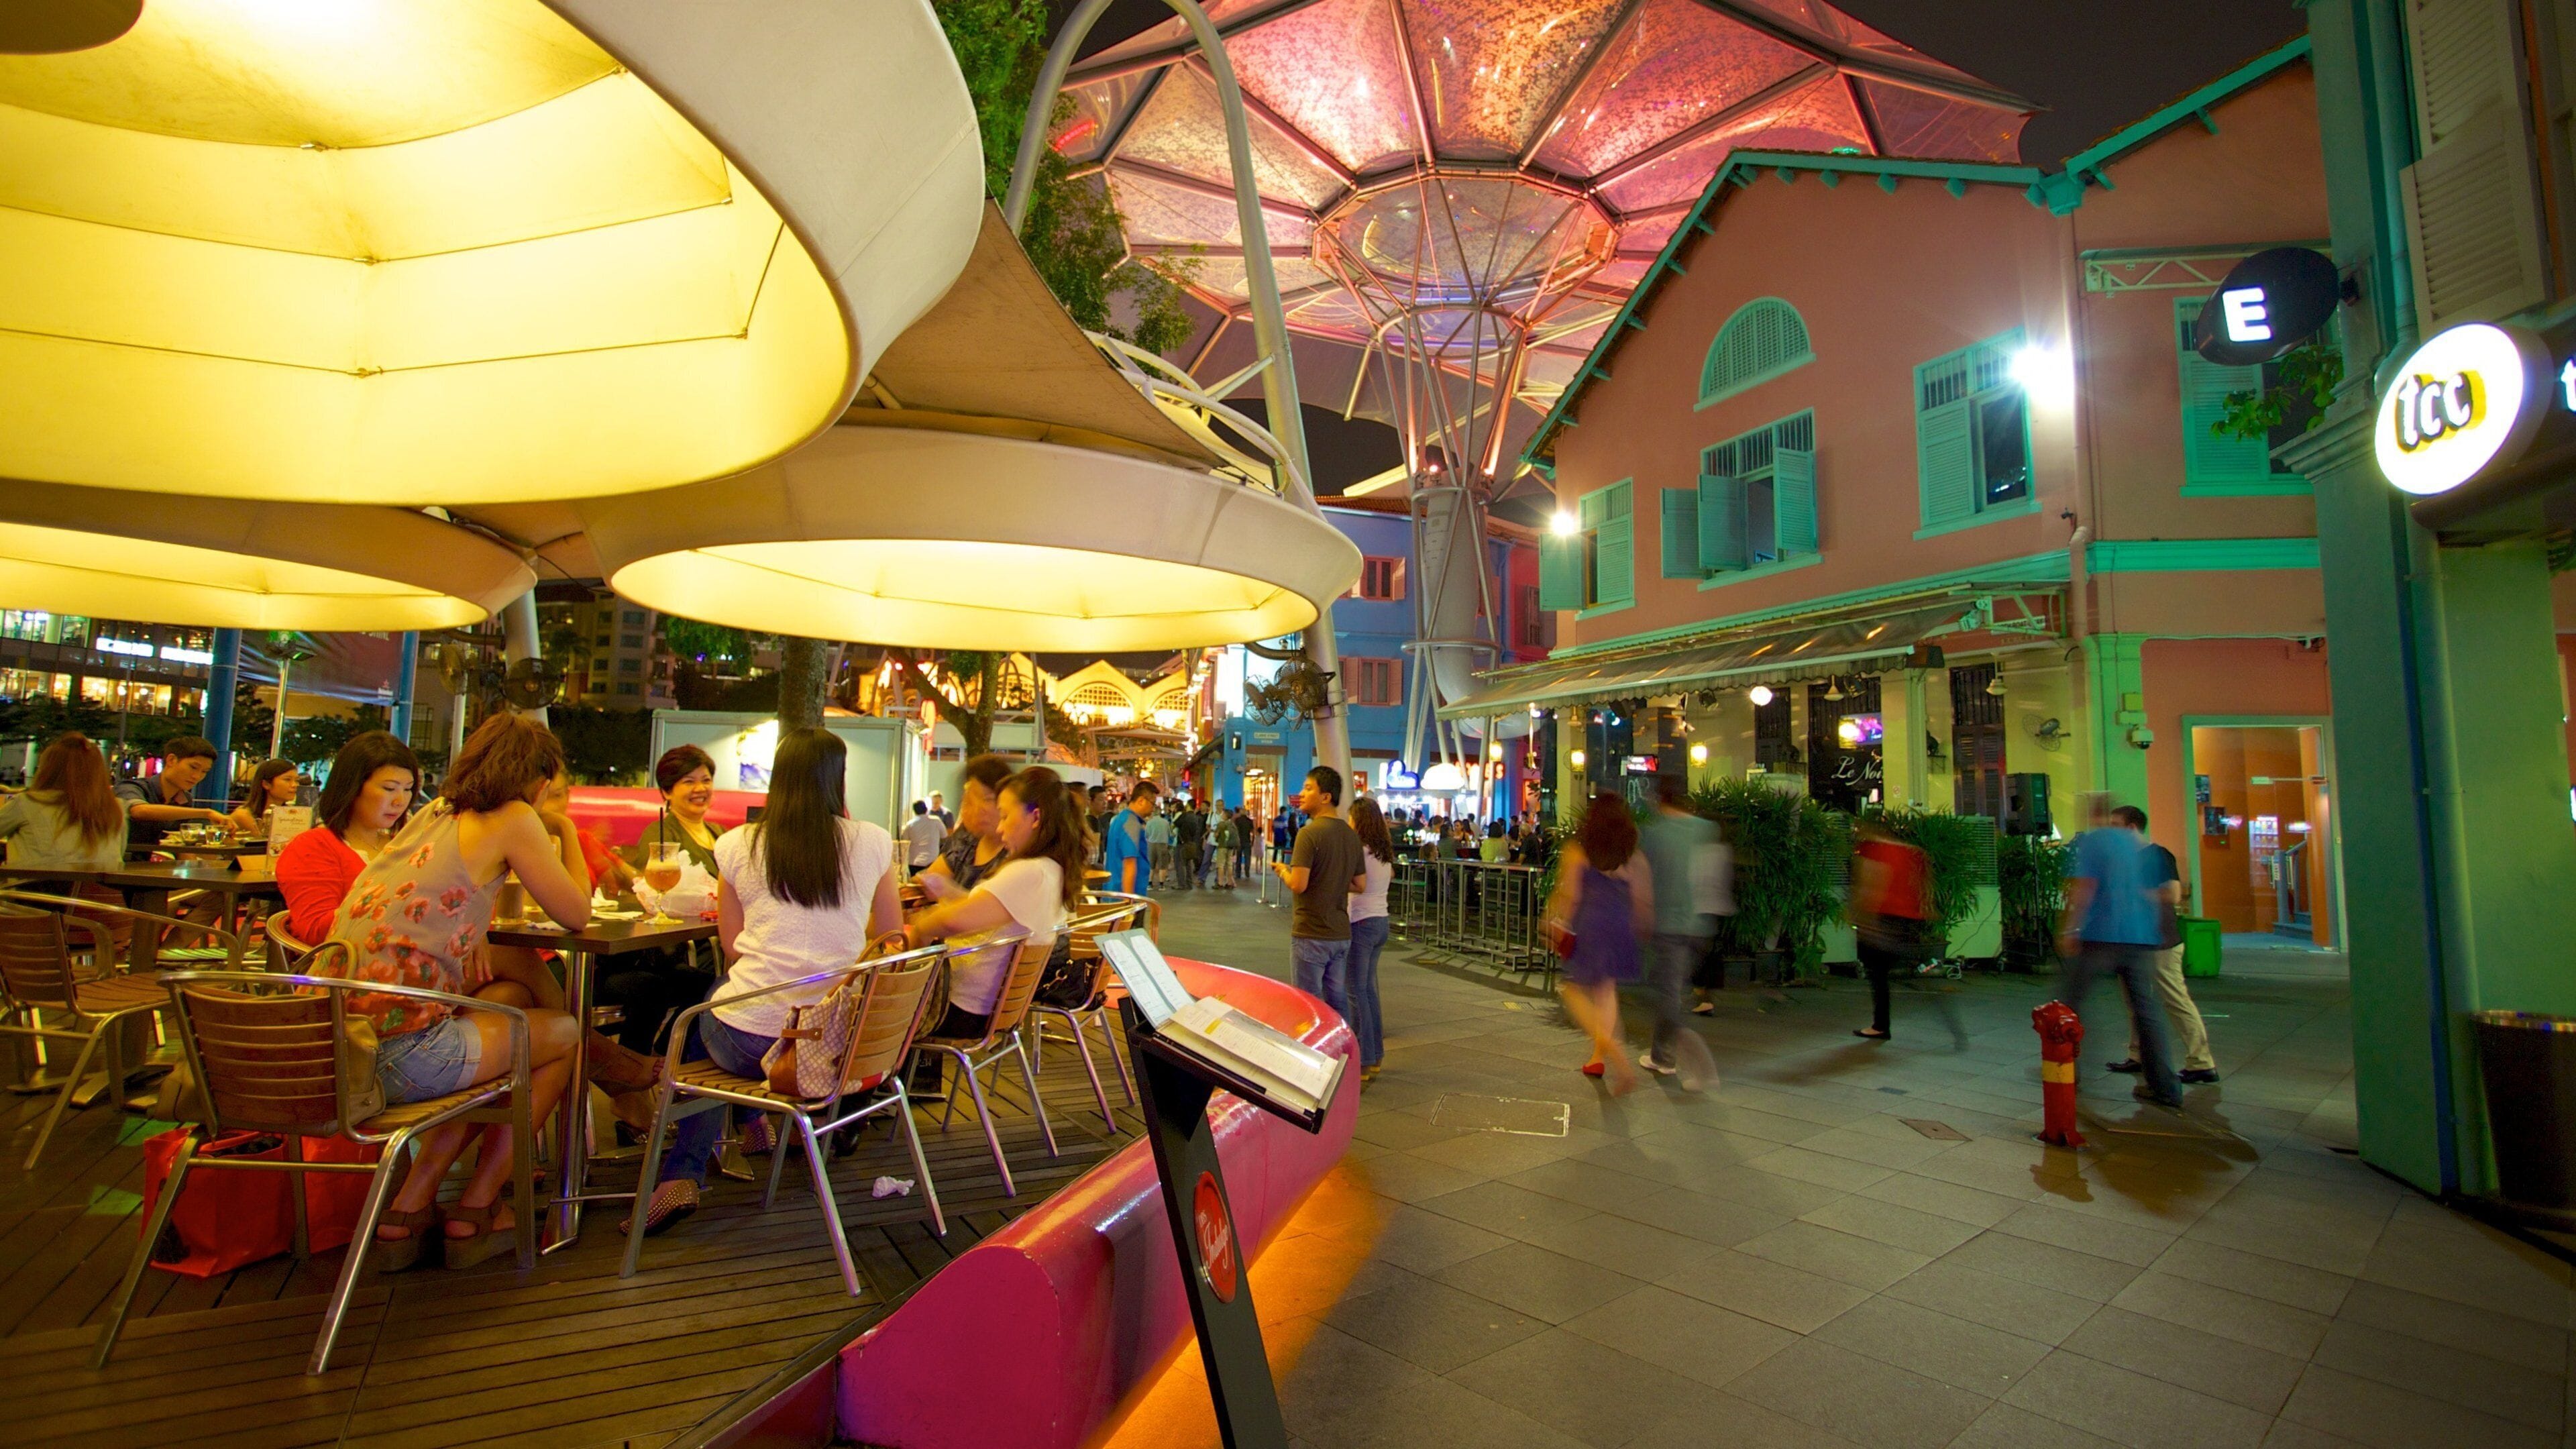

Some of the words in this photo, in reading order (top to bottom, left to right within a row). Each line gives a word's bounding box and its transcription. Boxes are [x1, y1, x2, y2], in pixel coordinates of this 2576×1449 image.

[2222, 286, 2272, 342] E
[2396, 372, 2473, 449] tcc
[1831, 755, 1855, 779] Le
[1845, 757, 1884, 786] Noi
